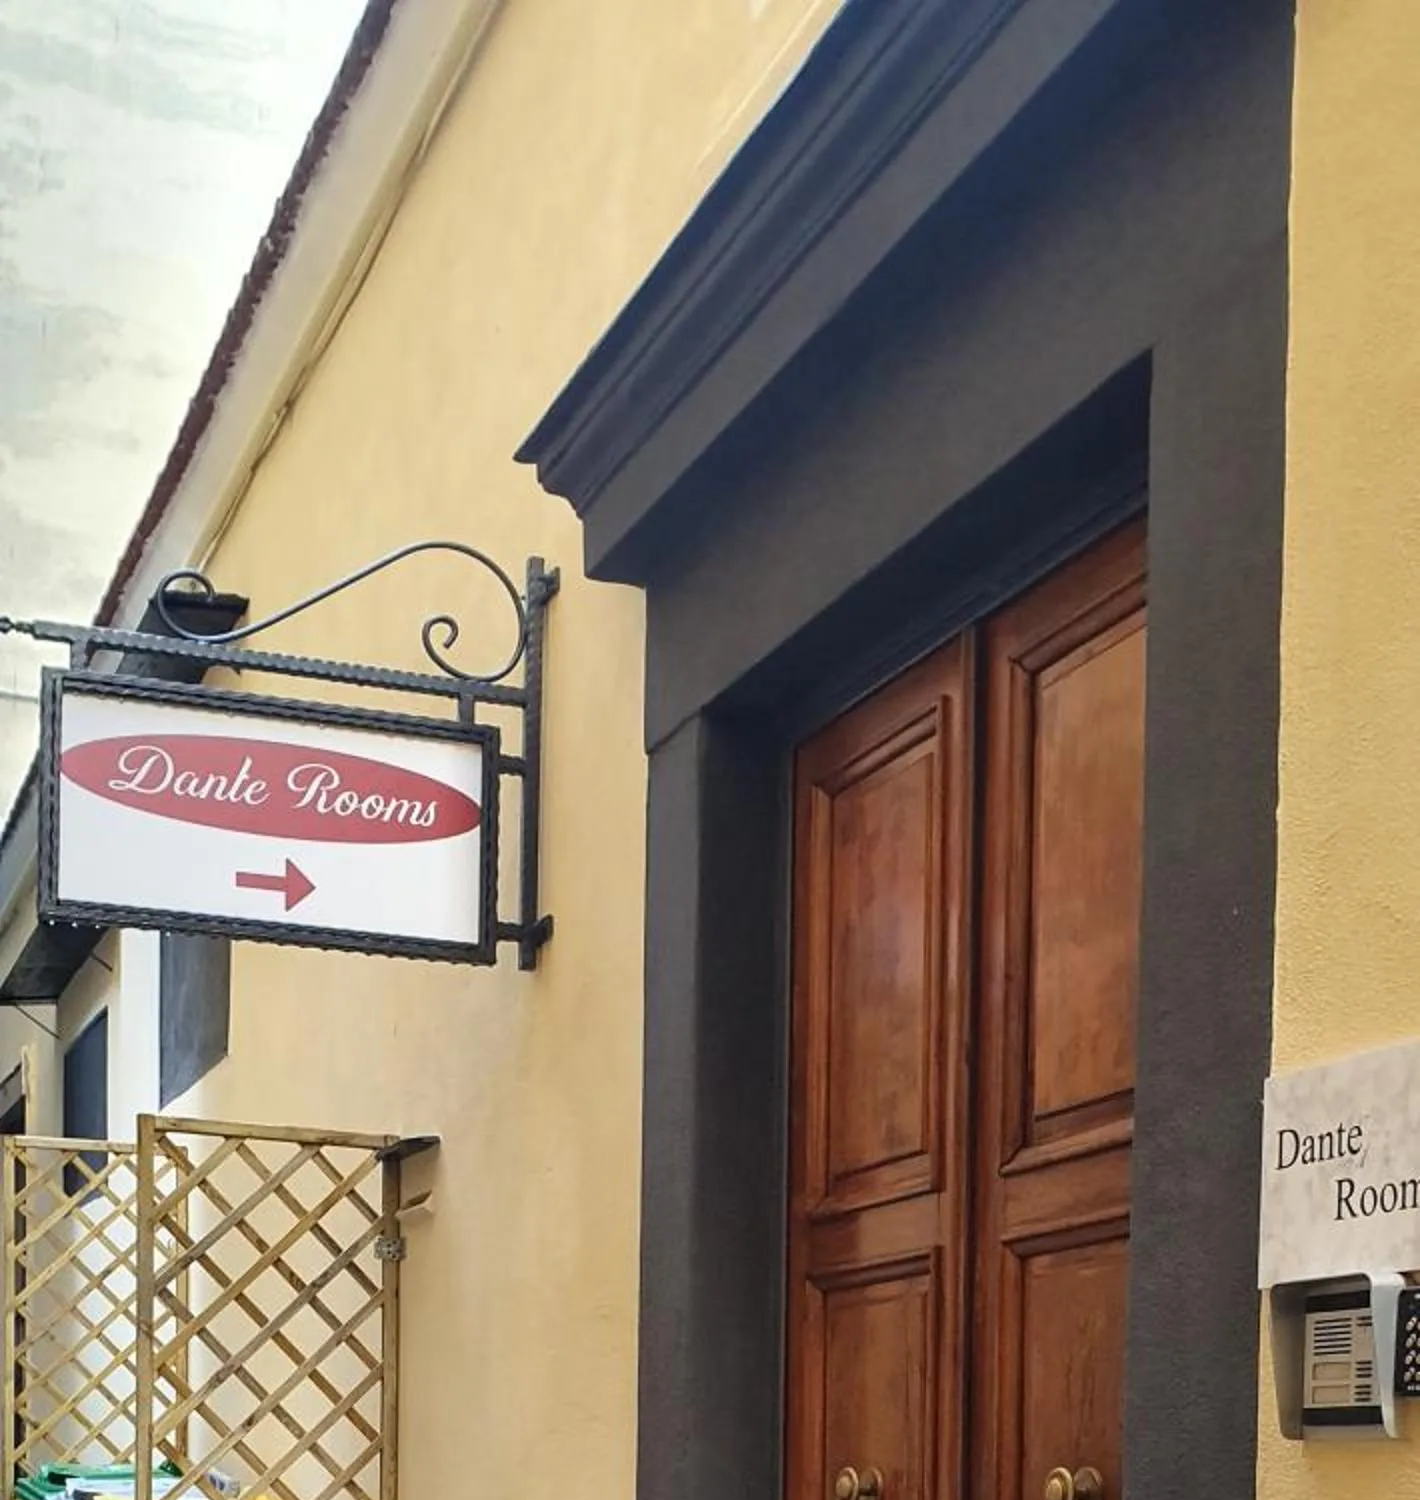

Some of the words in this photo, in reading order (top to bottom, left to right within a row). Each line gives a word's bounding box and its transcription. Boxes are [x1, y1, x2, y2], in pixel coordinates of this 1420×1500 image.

[107, 744, 270, 806] Dante
[287, 763, 438, 828] Rooms
[1275, 1121, 1364, 1170] Dante
